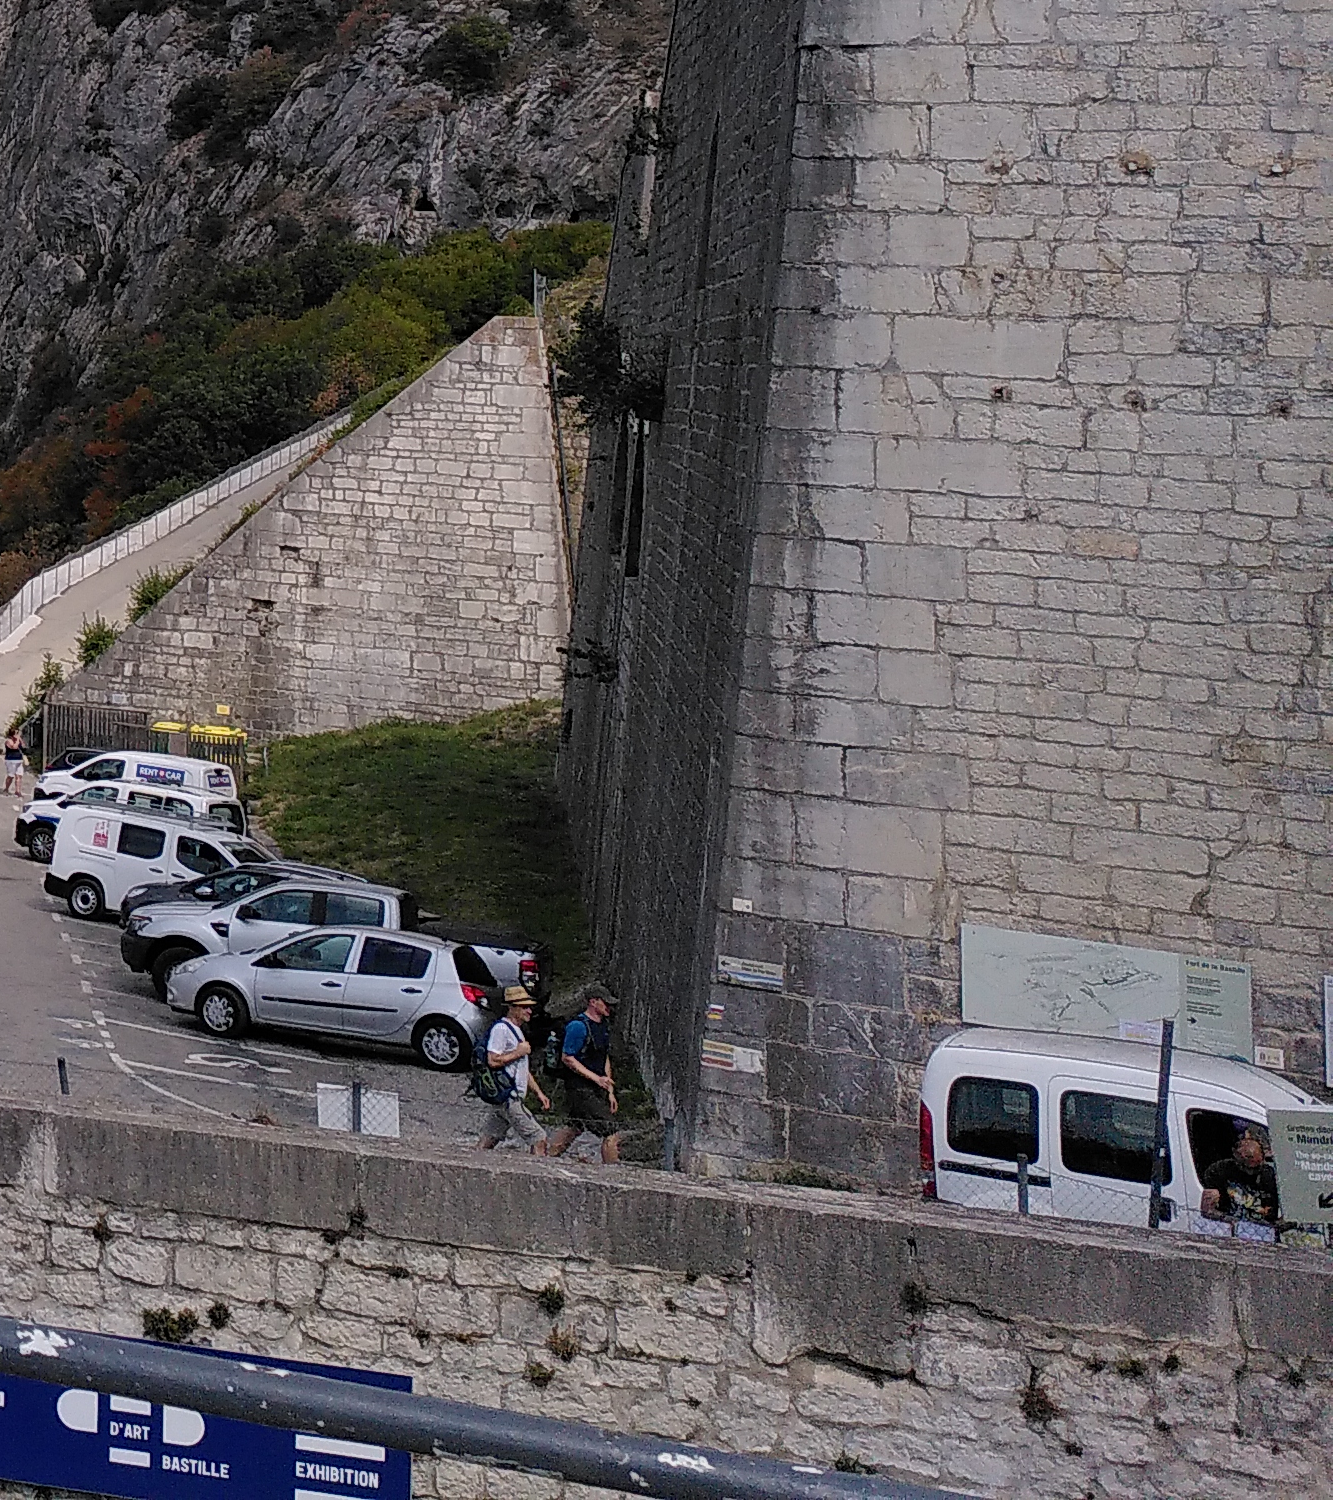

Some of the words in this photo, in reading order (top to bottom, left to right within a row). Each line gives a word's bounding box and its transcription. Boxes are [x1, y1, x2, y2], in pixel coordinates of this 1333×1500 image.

[139, 766, 158, 777] RENT
[165, 770, 182, 781] CAR
[109, 1421, 151, 1441] D'ART
[161, 1454, 230, 1479] BASTILLE
[295, 1461, 380, 1490] EXHIBITION
